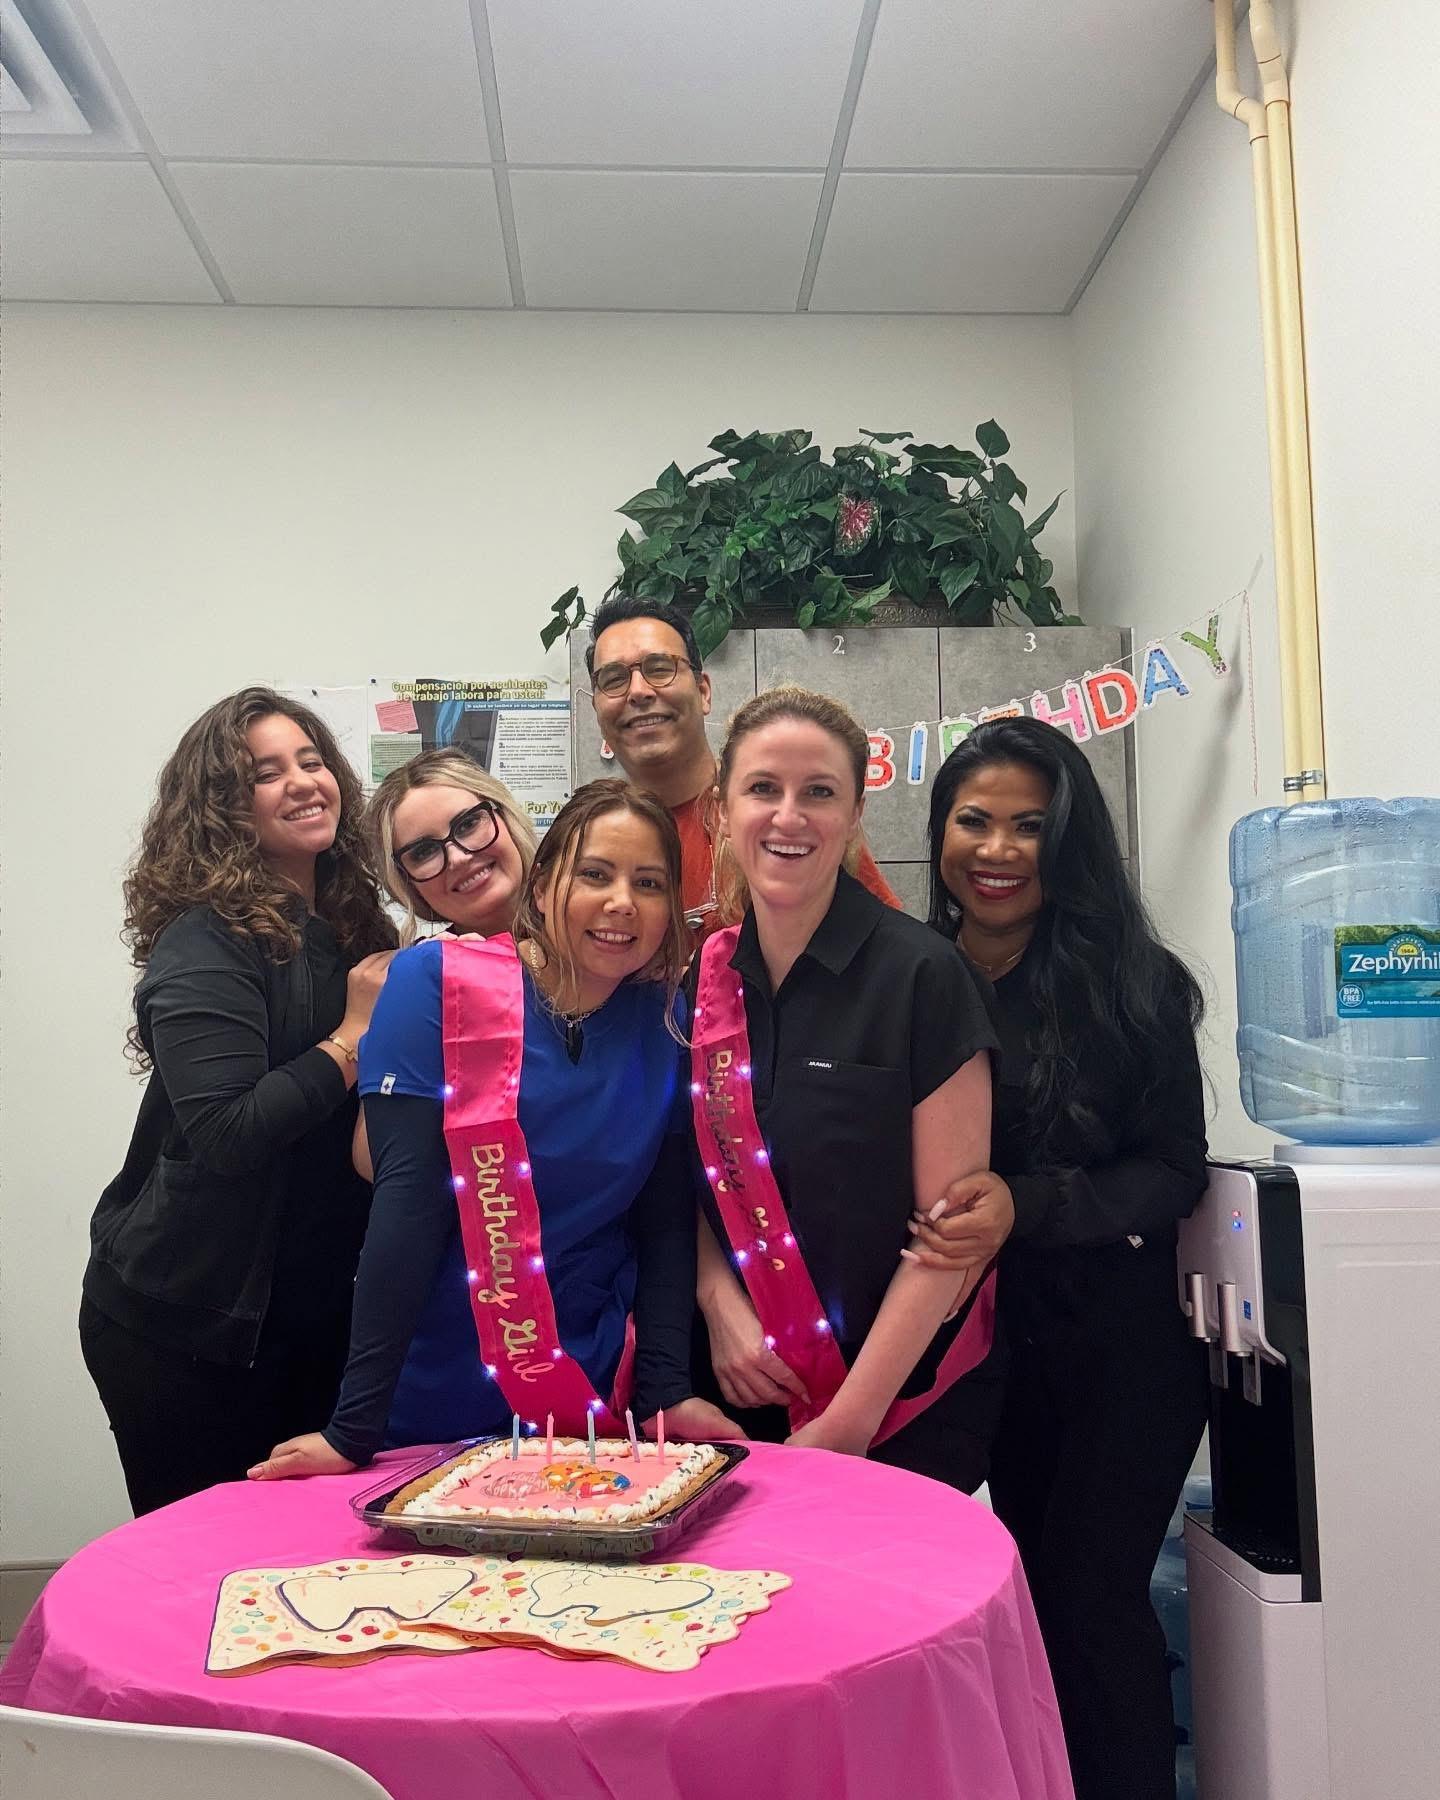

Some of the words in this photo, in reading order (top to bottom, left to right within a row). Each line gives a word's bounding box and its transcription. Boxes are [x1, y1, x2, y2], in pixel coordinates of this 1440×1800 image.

[832, 634, 844, 655] 2
[1023, 631, 1037, 652] 3
[470, 681, 488, 692] por
[411, 690, 449, 702] trabajo
[451, 689, 485, 700] labora
[486, 690, 511, 701] para
[524, 800, 547, 815] For
[1342, 994, 1361, 1002] FREE
[1343, 987, 1360, 995] BPA
[471, 1143, 521, 1309] Birthday
[498, 1317, 554, 1383] Girl
